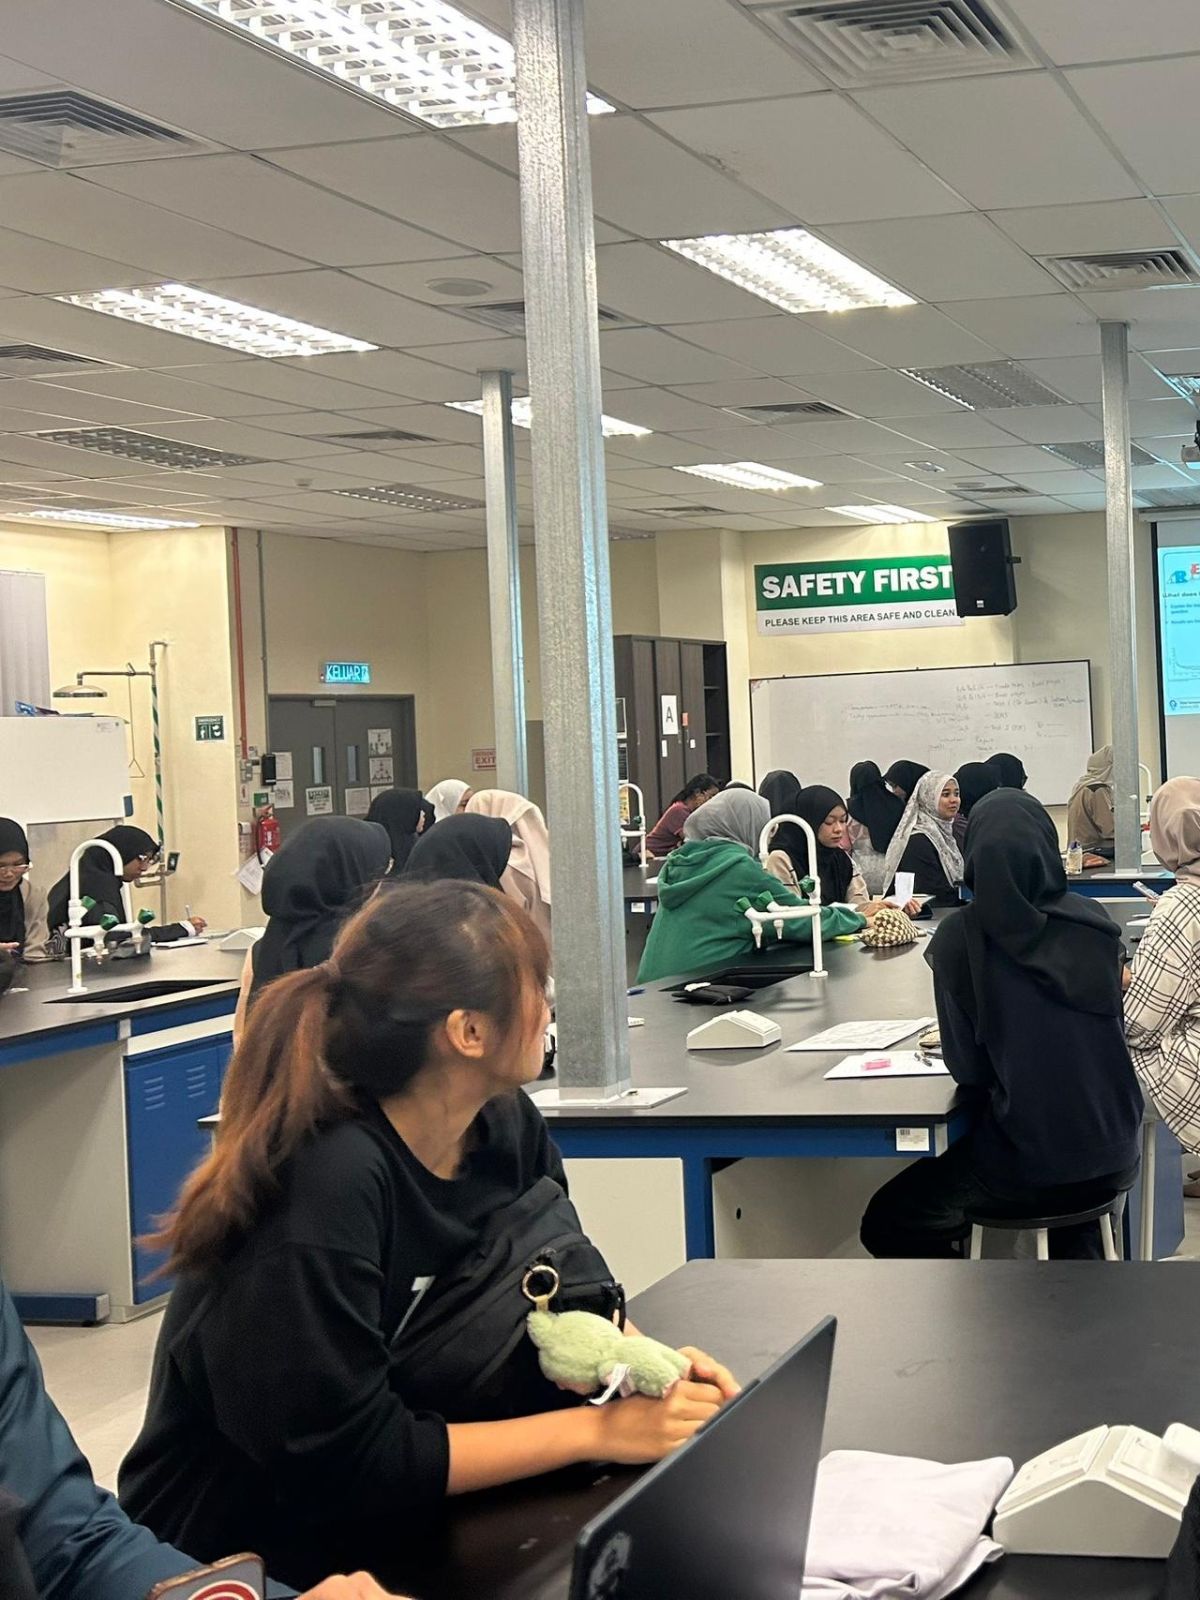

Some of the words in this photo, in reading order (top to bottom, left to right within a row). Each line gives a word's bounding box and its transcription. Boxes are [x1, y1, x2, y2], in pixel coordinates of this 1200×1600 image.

[762, 570, 866, 599] SAFETY
[873, 564, 952, 593] FIRST
[765, 618, 800, 627] PLEASE
[802, 616, 826, 625] KEEP
[828, 615, 848, 624] THIS
[850, 613, 875, 622] AREA
[877, 612, 901, 621] SAFE
[902, 610, 922, 619] AND
[923, 608, 956, 618] CLEAN
[326, 664, 361, 680] KELUAR
[666, 706, 674, 723] A
